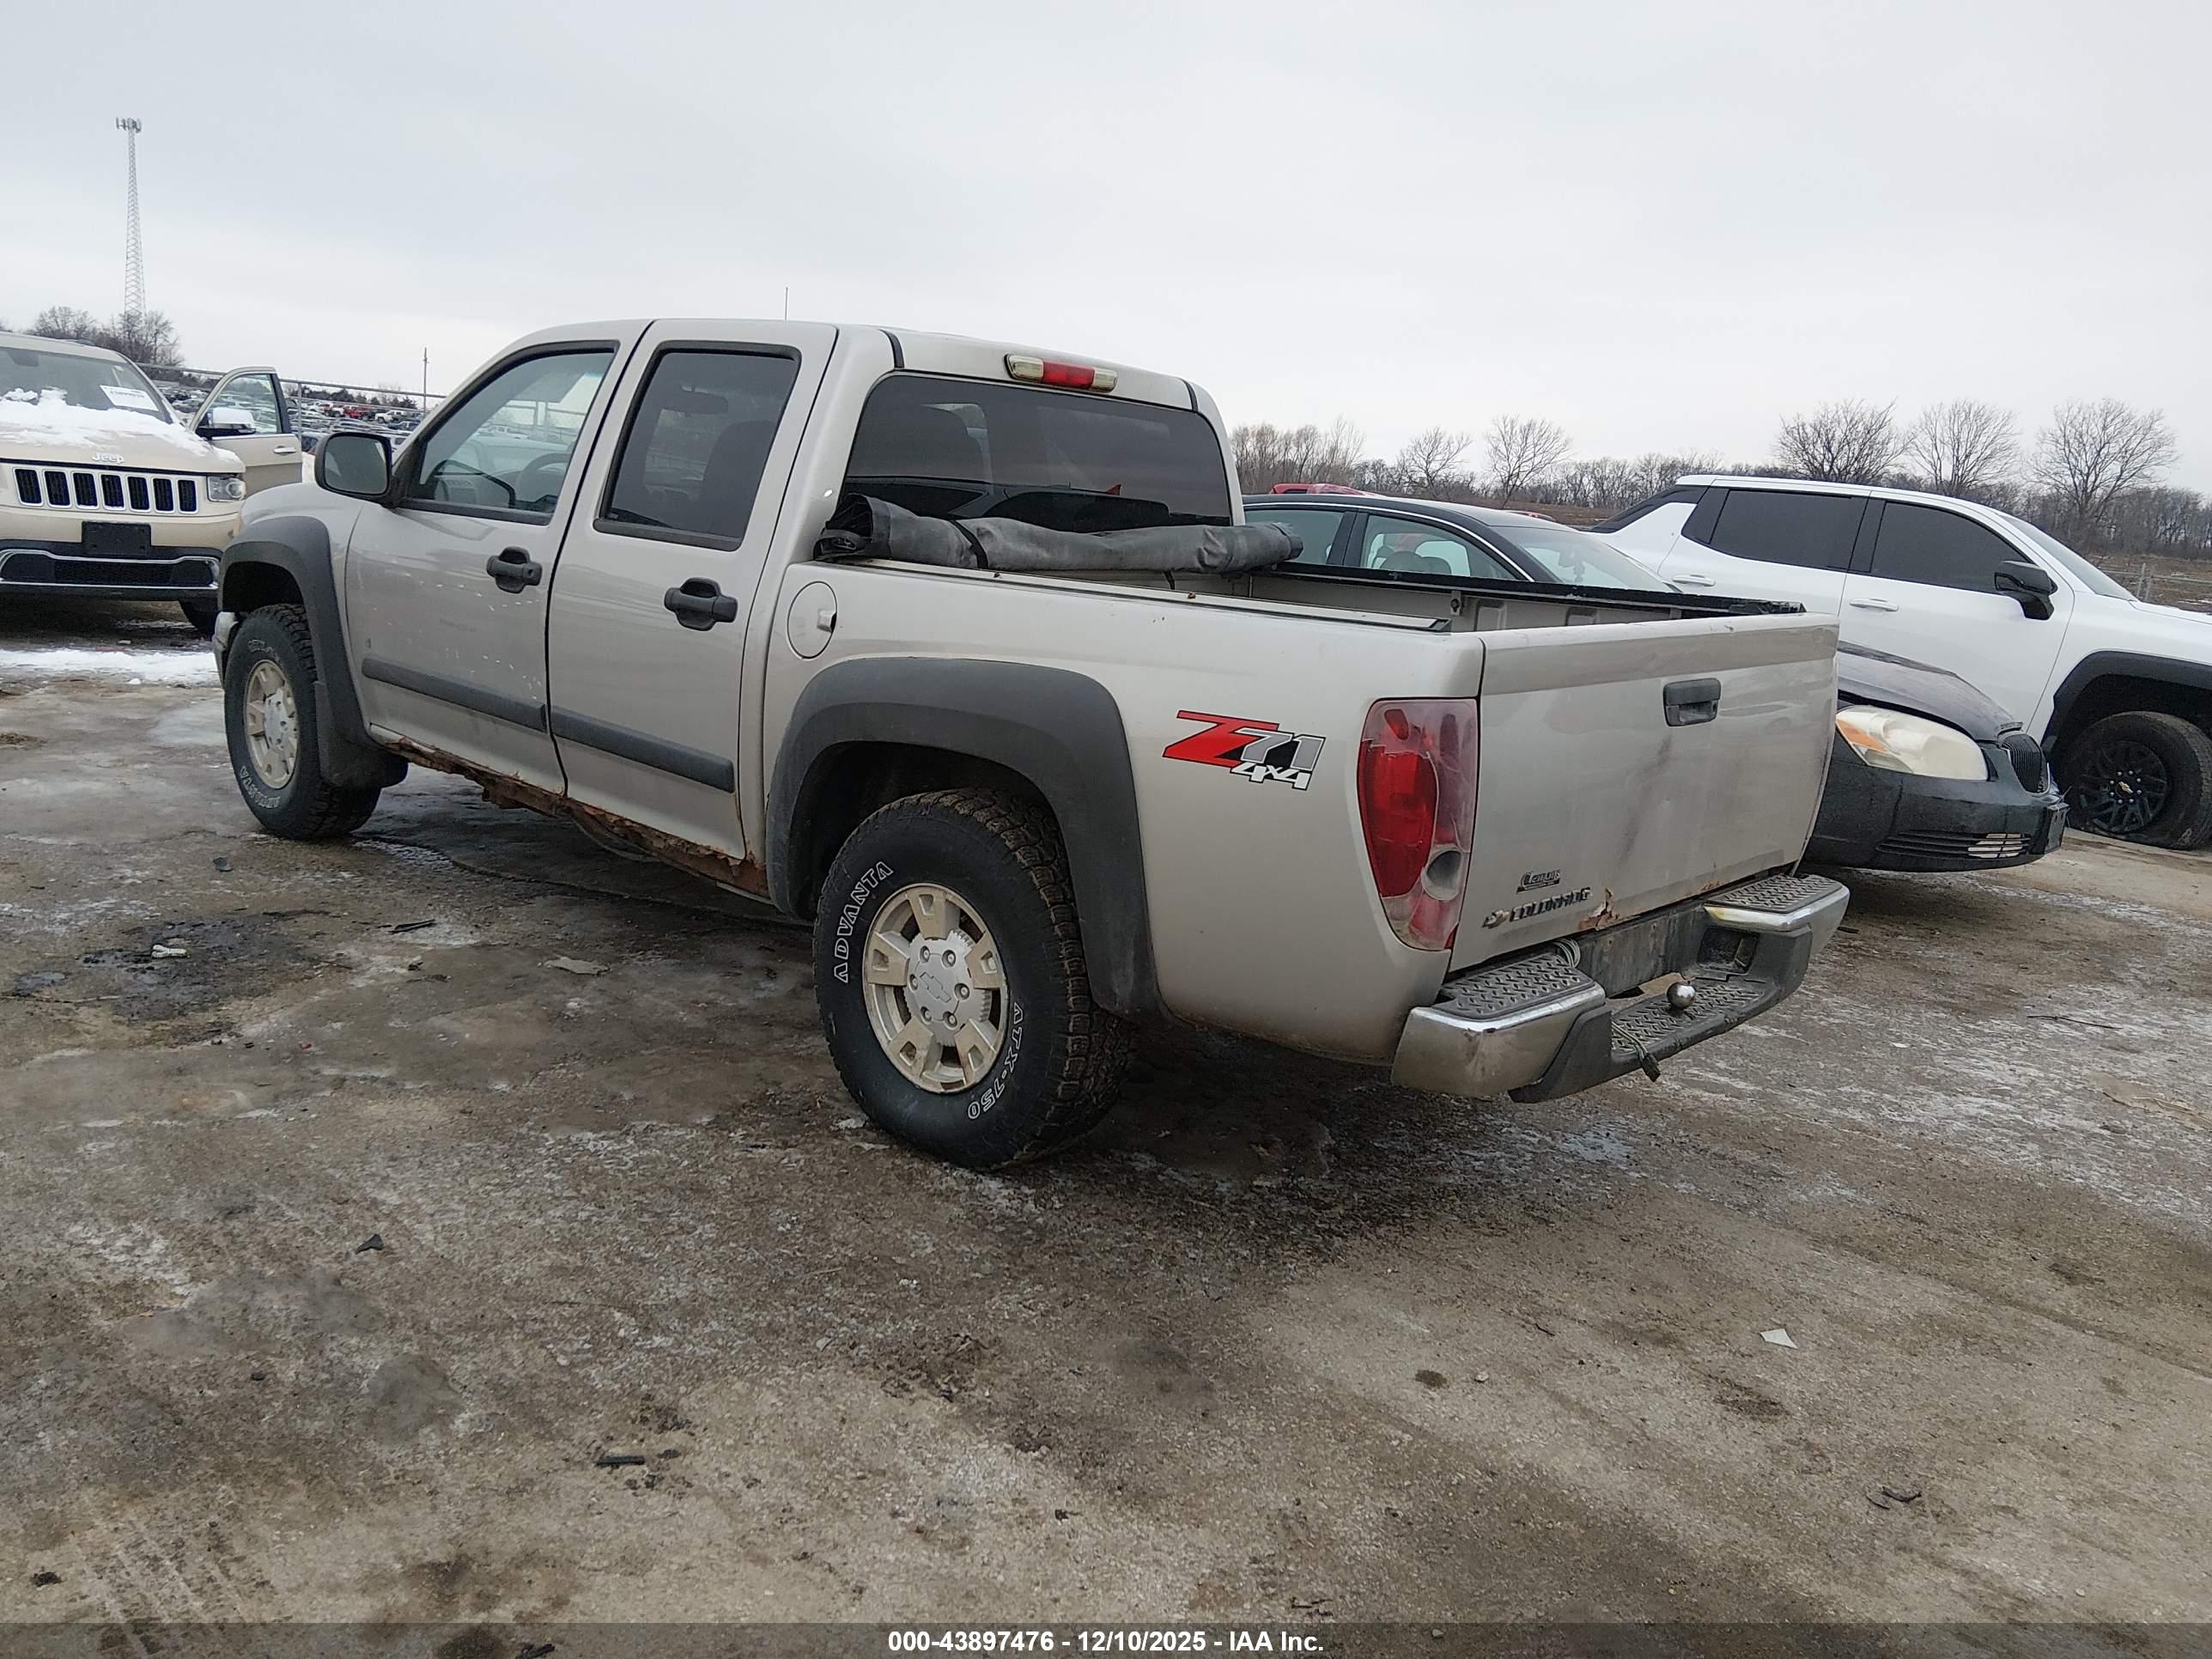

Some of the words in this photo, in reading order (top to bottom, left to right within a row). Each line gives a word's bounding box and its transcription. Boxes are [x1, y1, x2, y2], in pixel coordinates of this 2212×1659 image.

[91, 453, 125, 465] Jeep
[1162, 709, 1327, 772] Z71
[833, 860, 894, 983] ADVANTA
